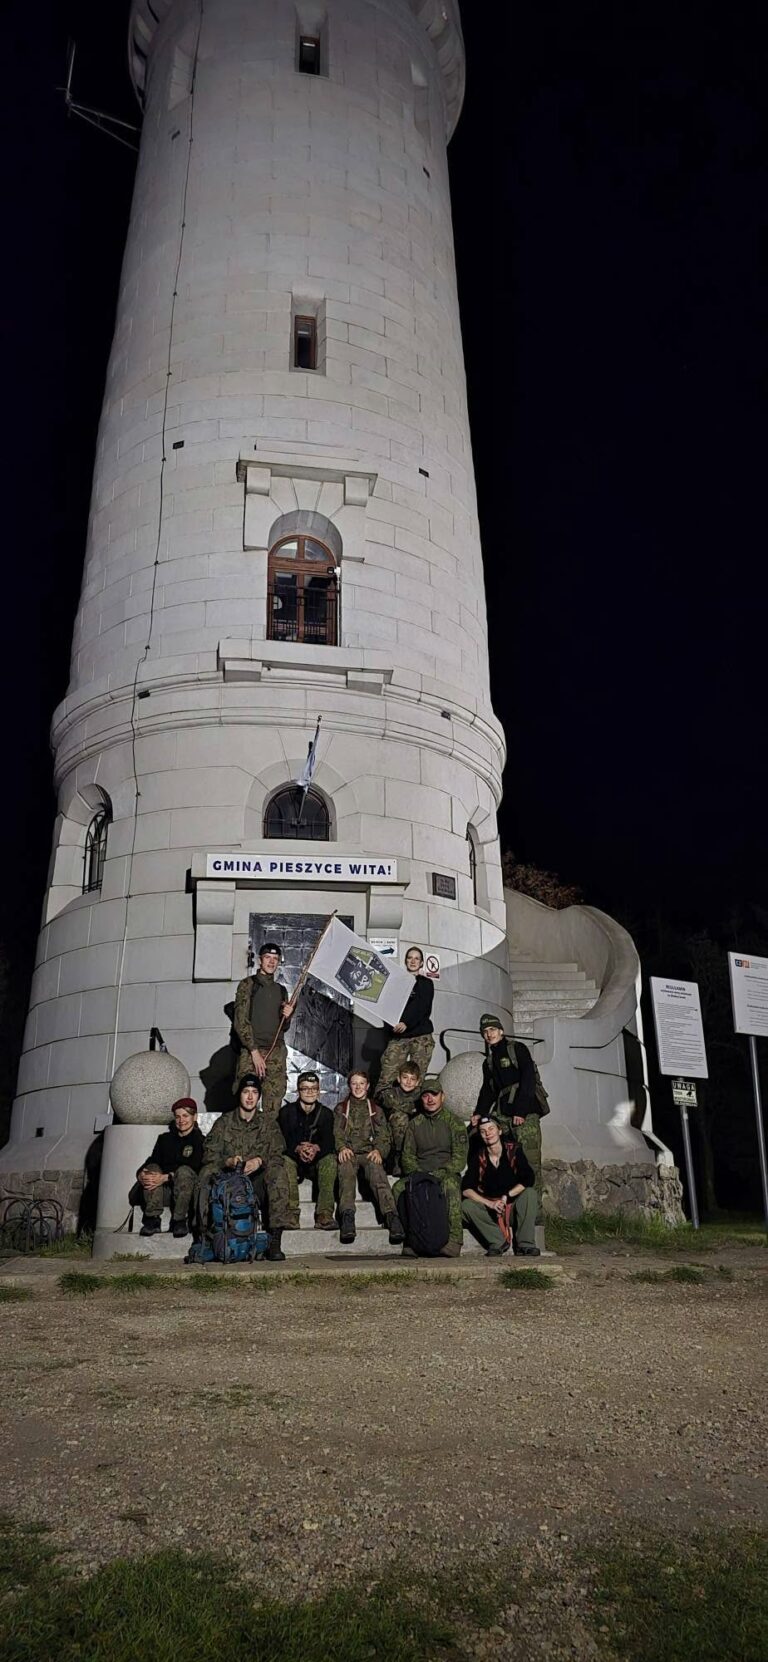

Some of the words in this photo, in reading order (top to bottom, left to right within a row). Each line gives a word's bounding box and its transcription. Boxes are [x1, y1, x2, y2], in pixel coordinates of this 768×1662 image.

[212, 860, 263, 872] GMINA
[269, 862, 342, 874] PIESZYCE
[349, 864, 392, 875] WITA!
[673, 1081, 695, 1091] UWAGA
